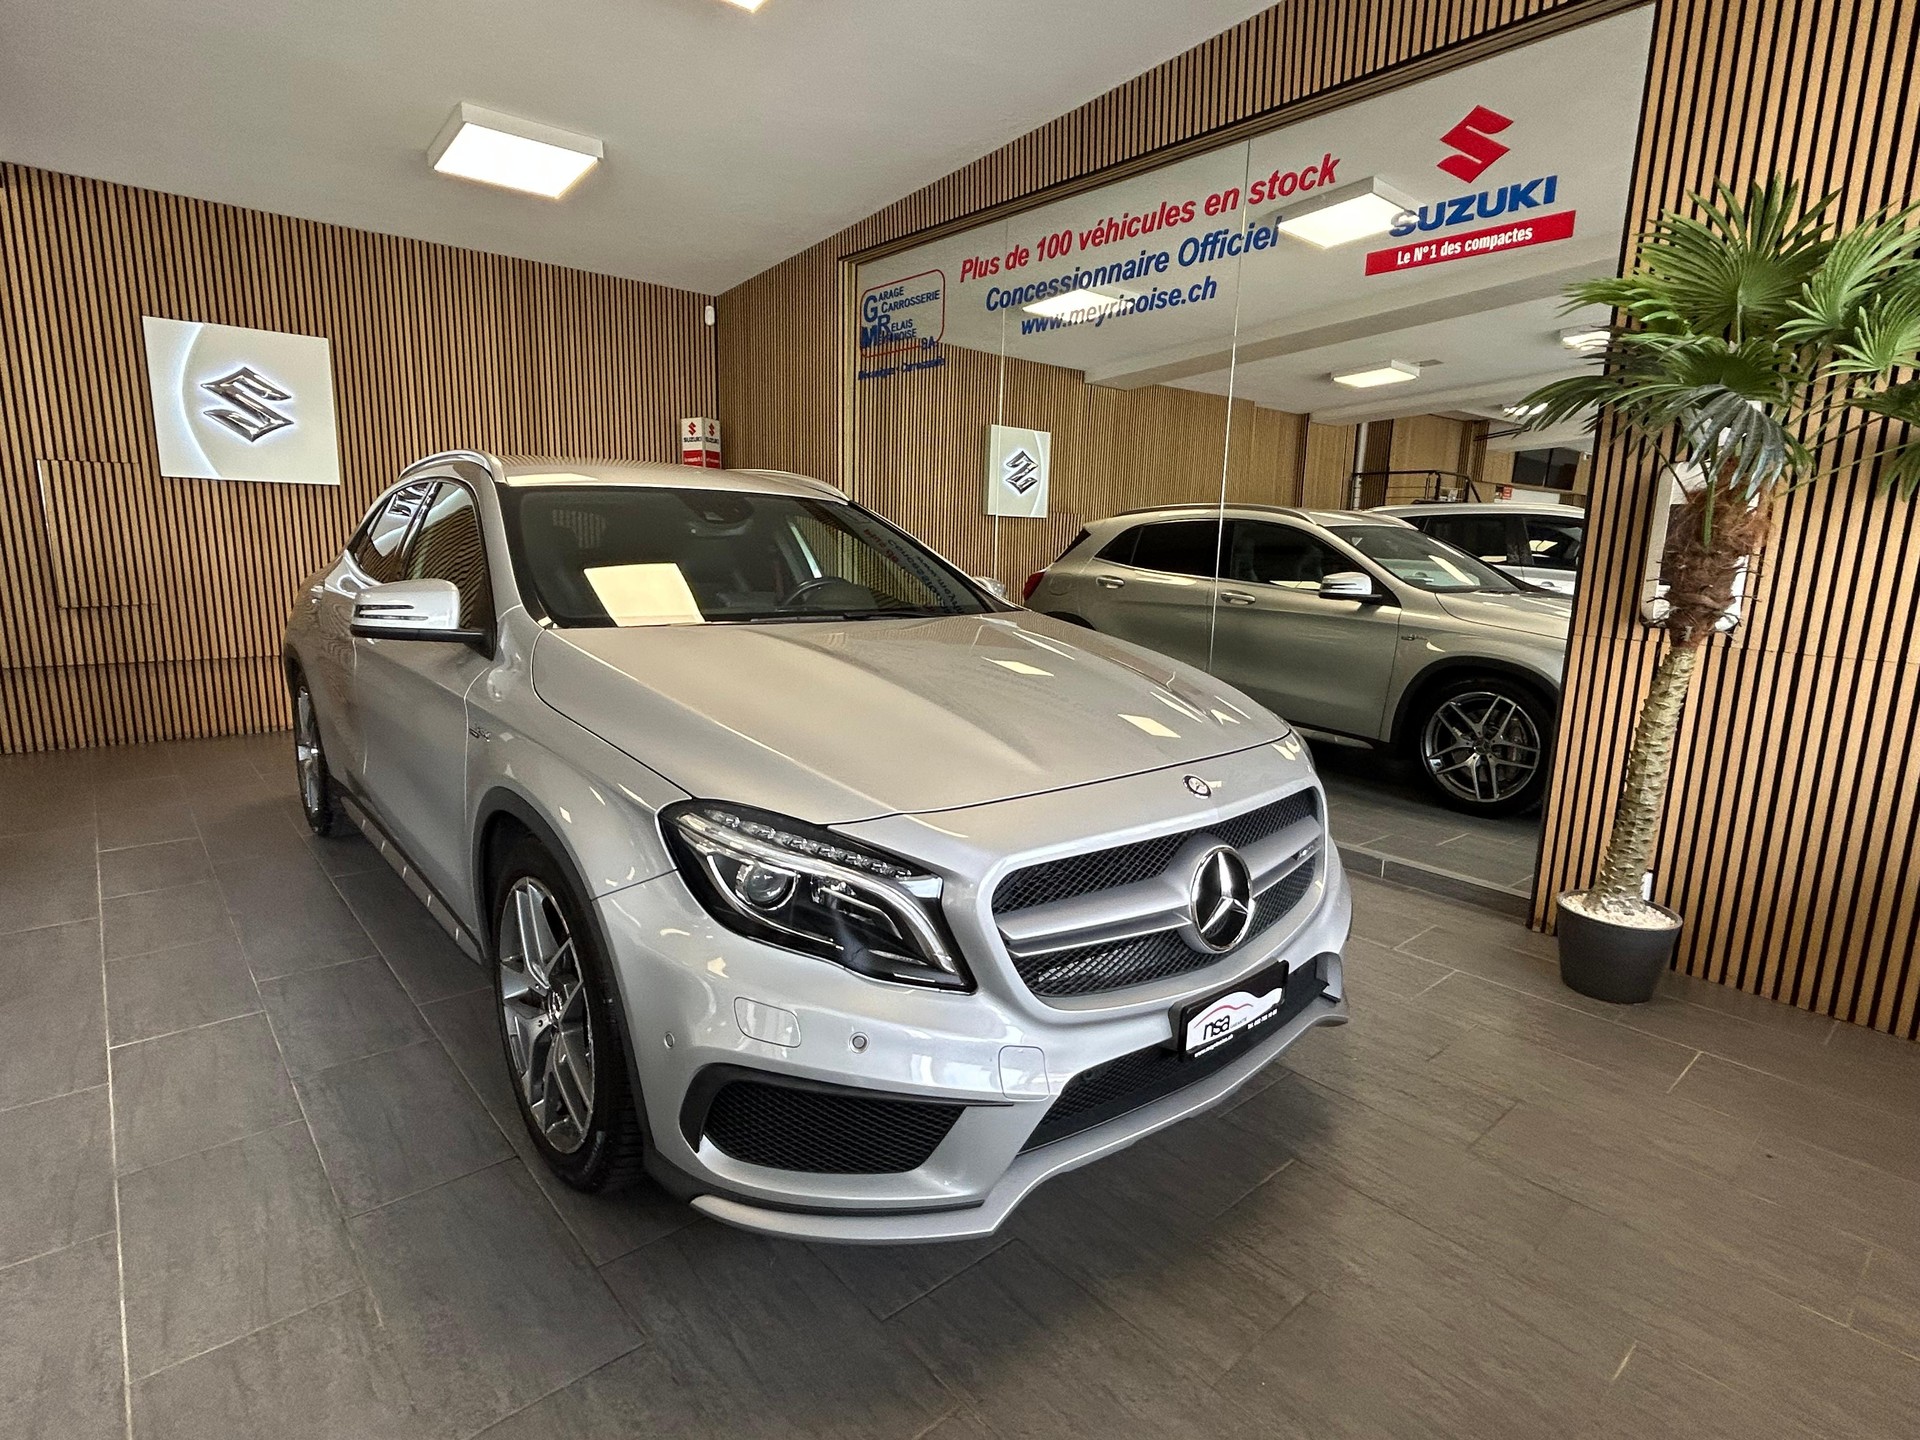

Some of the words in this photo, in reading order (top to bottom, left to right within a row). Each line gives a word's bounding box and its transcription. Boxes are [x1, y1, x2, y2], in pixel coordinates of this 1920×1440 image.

[960, 256, 1000, 283] Plus
[1004, 244, 1029, 271] de
[1036, 229, 1072, 262] 100
[1079, 199, 1196, 251] véhicules
[1204, 187, 1240, 216] en
[1248, 153, 1340, 205] stock
[1389, 175, 1558, 237] SUZUKI
[986, 249, 1170, 311] Concessionnaire
[1178, 215, 1283, 267] Officiel
[1397, 251, 1410, 265] Le
[1440, 241, 1461, 256] des
[1464, 227, 1533, 252] compactes
[863, 286, 905, 323] GARAGE
[881, 290, 941, 314] CARROSSERIE
[1021, 276, 1217, 335] www.meyrinoise.ch
[877, 314, 913, 337] RELAIS
[1203, 1014, 1230, 1040] nsa
